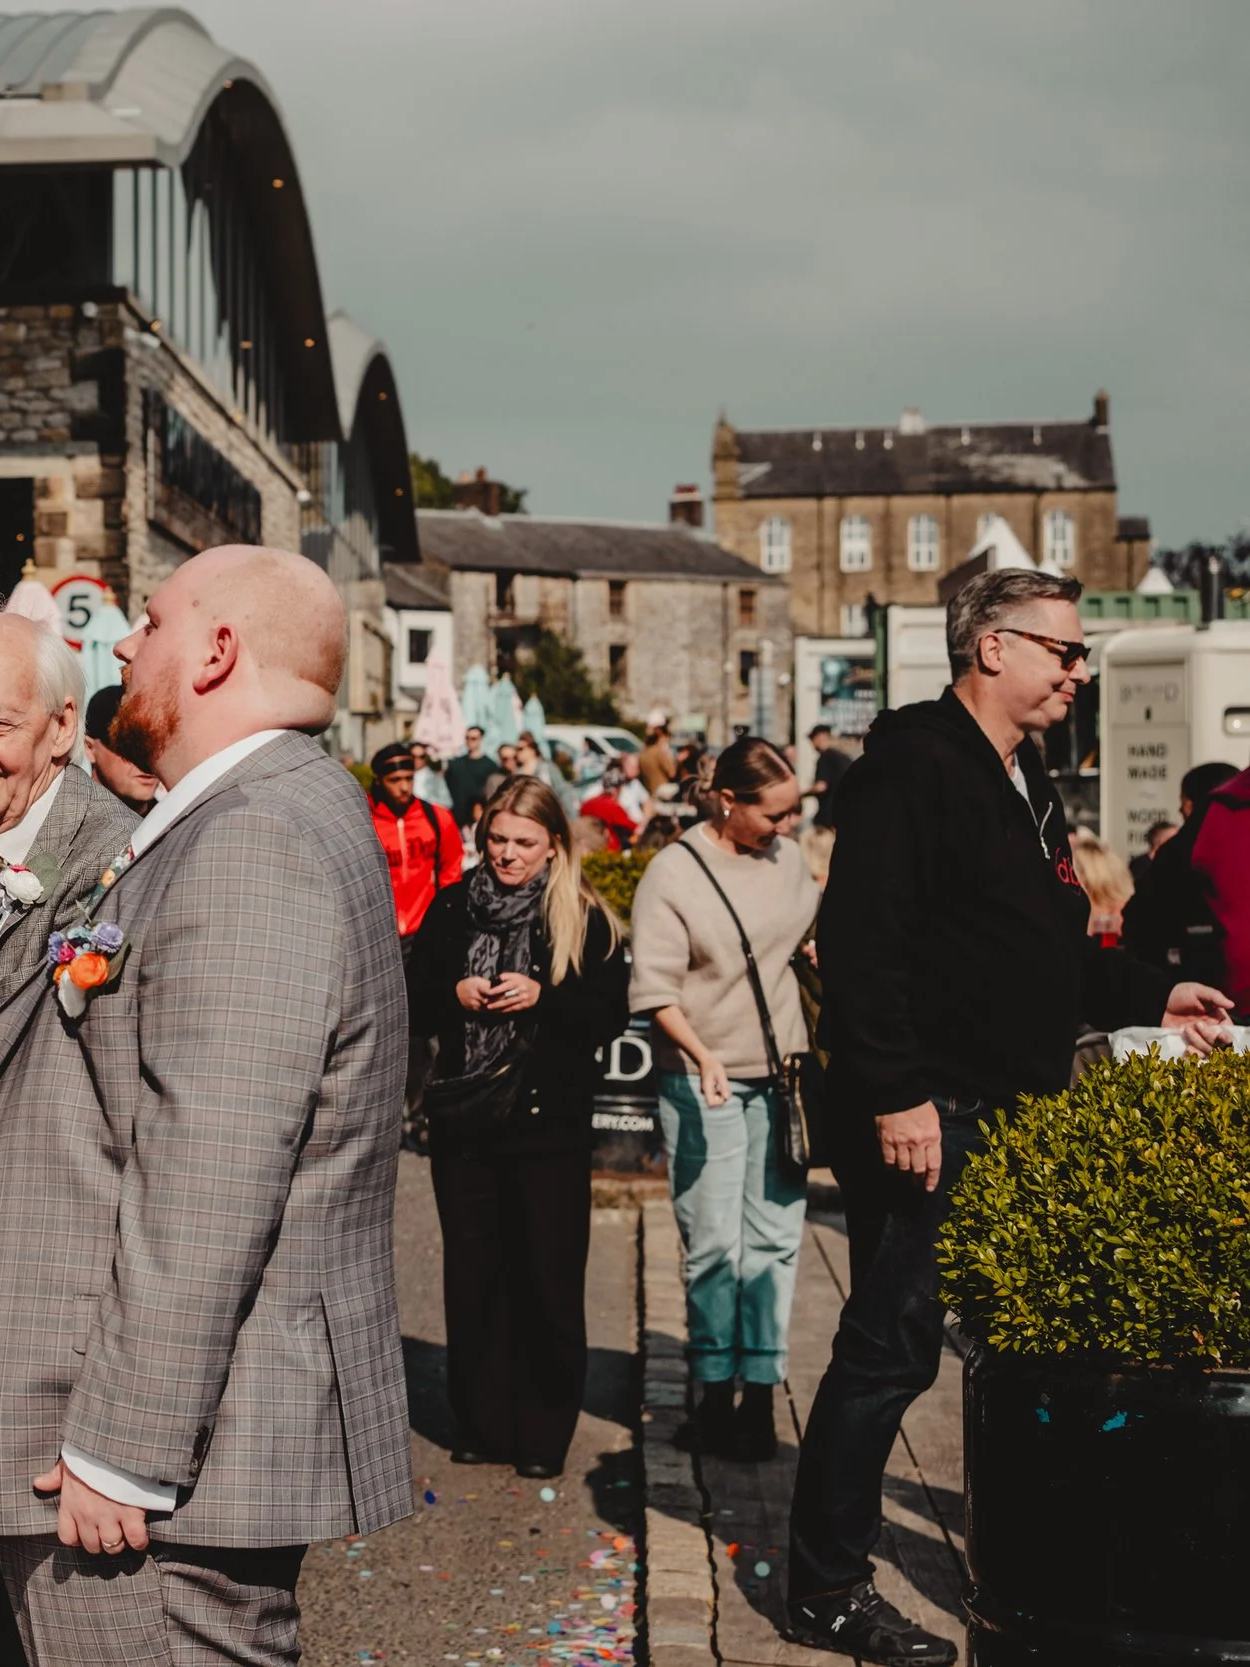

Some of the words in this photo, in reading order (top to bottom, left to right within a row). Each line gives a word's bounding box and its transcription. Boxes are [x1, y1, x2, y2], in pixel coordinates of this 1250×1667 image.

[67, 594, 92, 628] 5
[1128, 743, 1169, 757] HAND
[1128, 765, 1168, 779] MADE
[1127, 808, 1169, 823] WOOD
